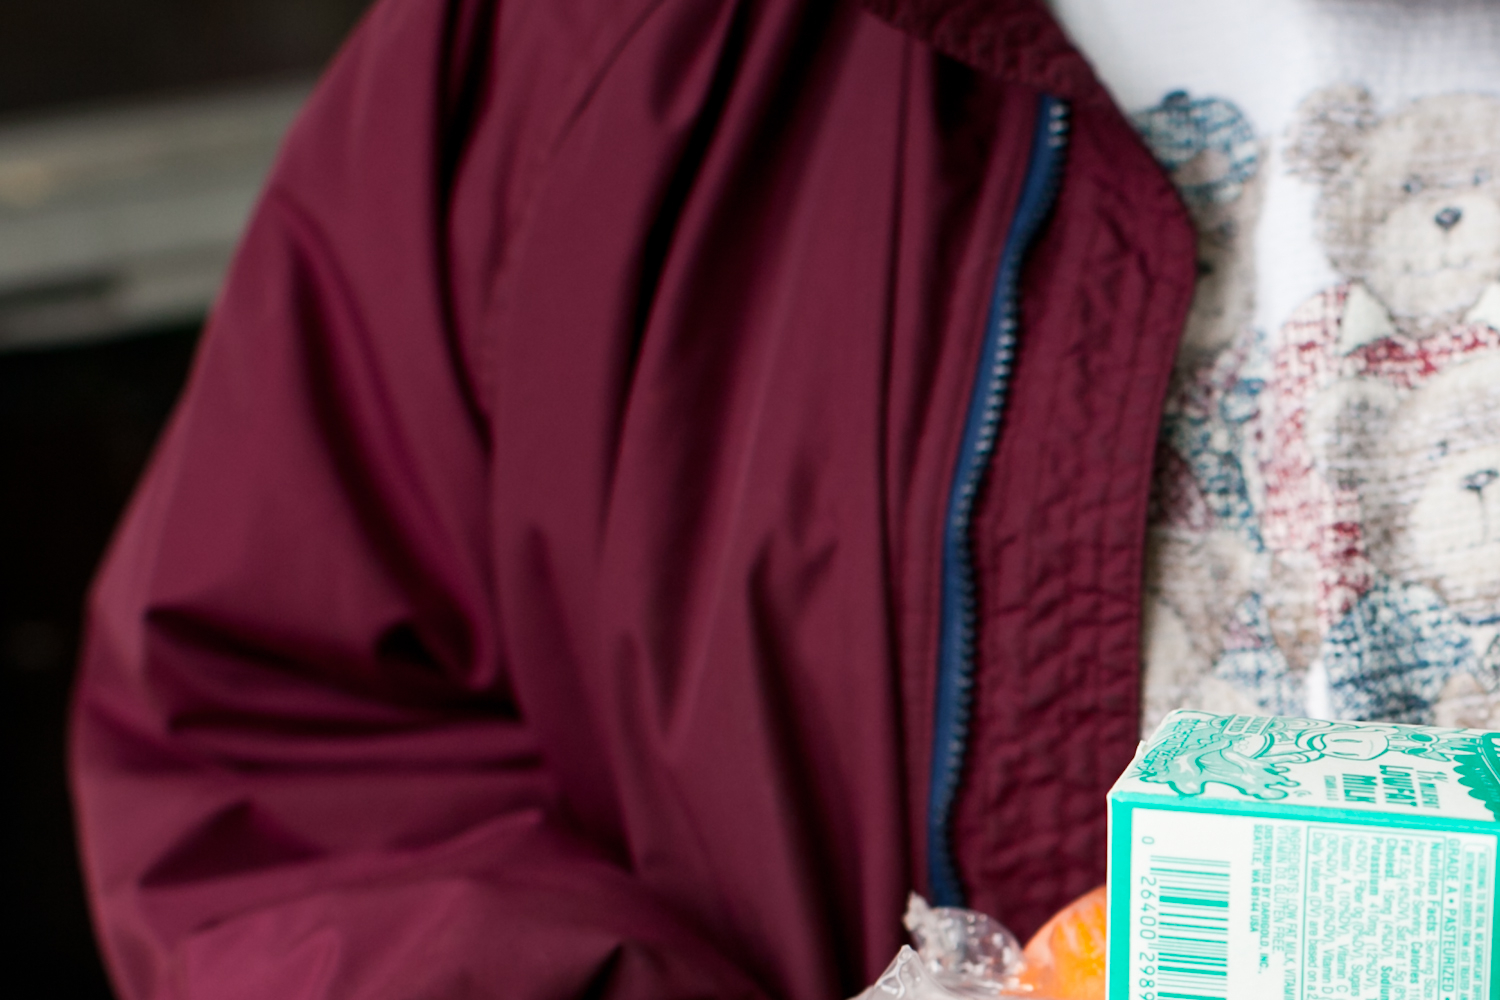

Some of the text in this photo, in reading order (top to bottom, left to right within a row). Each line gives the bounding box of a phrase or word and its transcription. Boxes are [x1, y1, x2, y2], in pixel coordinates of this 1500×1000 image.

[1341, 773, 1376, 803] MILK
[1379, 764, 1416, 807] LOWFAT
[1416, 770, 1448, 809] 1% MILKFAT
[1141, 836, 1154, 844] 0
[1309, 831, 1324, 856] Daily
[1322, 833, 1338, 880] (30%DV),
[1352, 836, 1368, 875] (4%DV),
[1287, 826, 1300, 895] INGREDIENTS:
[1310, 860, 1323, 892] Values
[1369, 836, 1382, 896] Potassium
[1384, 837, 1397, 881] Cholest.
[1413, 840, 1426, 877] Amount
[1428, 841, 1442, 896] Nutrition
[1446, 838, 1460, 880] GRADE
[1250, 823, 1262, 932] SEATTLE, WA 98144 USA
[1272, 825, 1287, 954] VITAMIN D3. GLUTEN FREE.
[1324, 883, 1336, 902] Iron
[1354, 879, 1366, 903] Fiber
[1412, 880, 1425, 896] Per
[1139, 876, 1156, 940] 26400
[1257, 824, 1272, 974] DISTRIBUTED BY DARIGOLD, INC.,
[1286, 898, 1298, 920] LOW
[1307, 895, 1322, 918] (DV)
[1350, 906, 1365, 919] 0g
[1379, 889, 1395, 915] 15mg
[1426, 899, 1440, 935] Facts:
[1285, 922, 1297, 938] FAT
[1309, 920, 1318, 936] are
[1320, 905, 1336, 945] (0%DV),
[1365, 902, 1380, 937] 410mg
[1408, 899, 1424, 937] Serving:
[1283, 941, 1297, 966] MILK,
[1308, 938, 1320, 968] based
[1349, 921, 1365, 960] (0%DV),
[1378, 920, 1394, 960] (4%DV),
[1421, 939, 1438, 975] Serving
[1441, 907, 1457, 992] PASTEURIZED
[1308, 970, 1317, 982] on
[1321, 948, 1334, 984] Vitamin
[1348, 963, 1363, 997] Sugars
[1363, 942, 1378, 990] (12%DV),
[1409, 940, 1422, 984] Calories
[1423, 978, 1436, 1000] Size:
